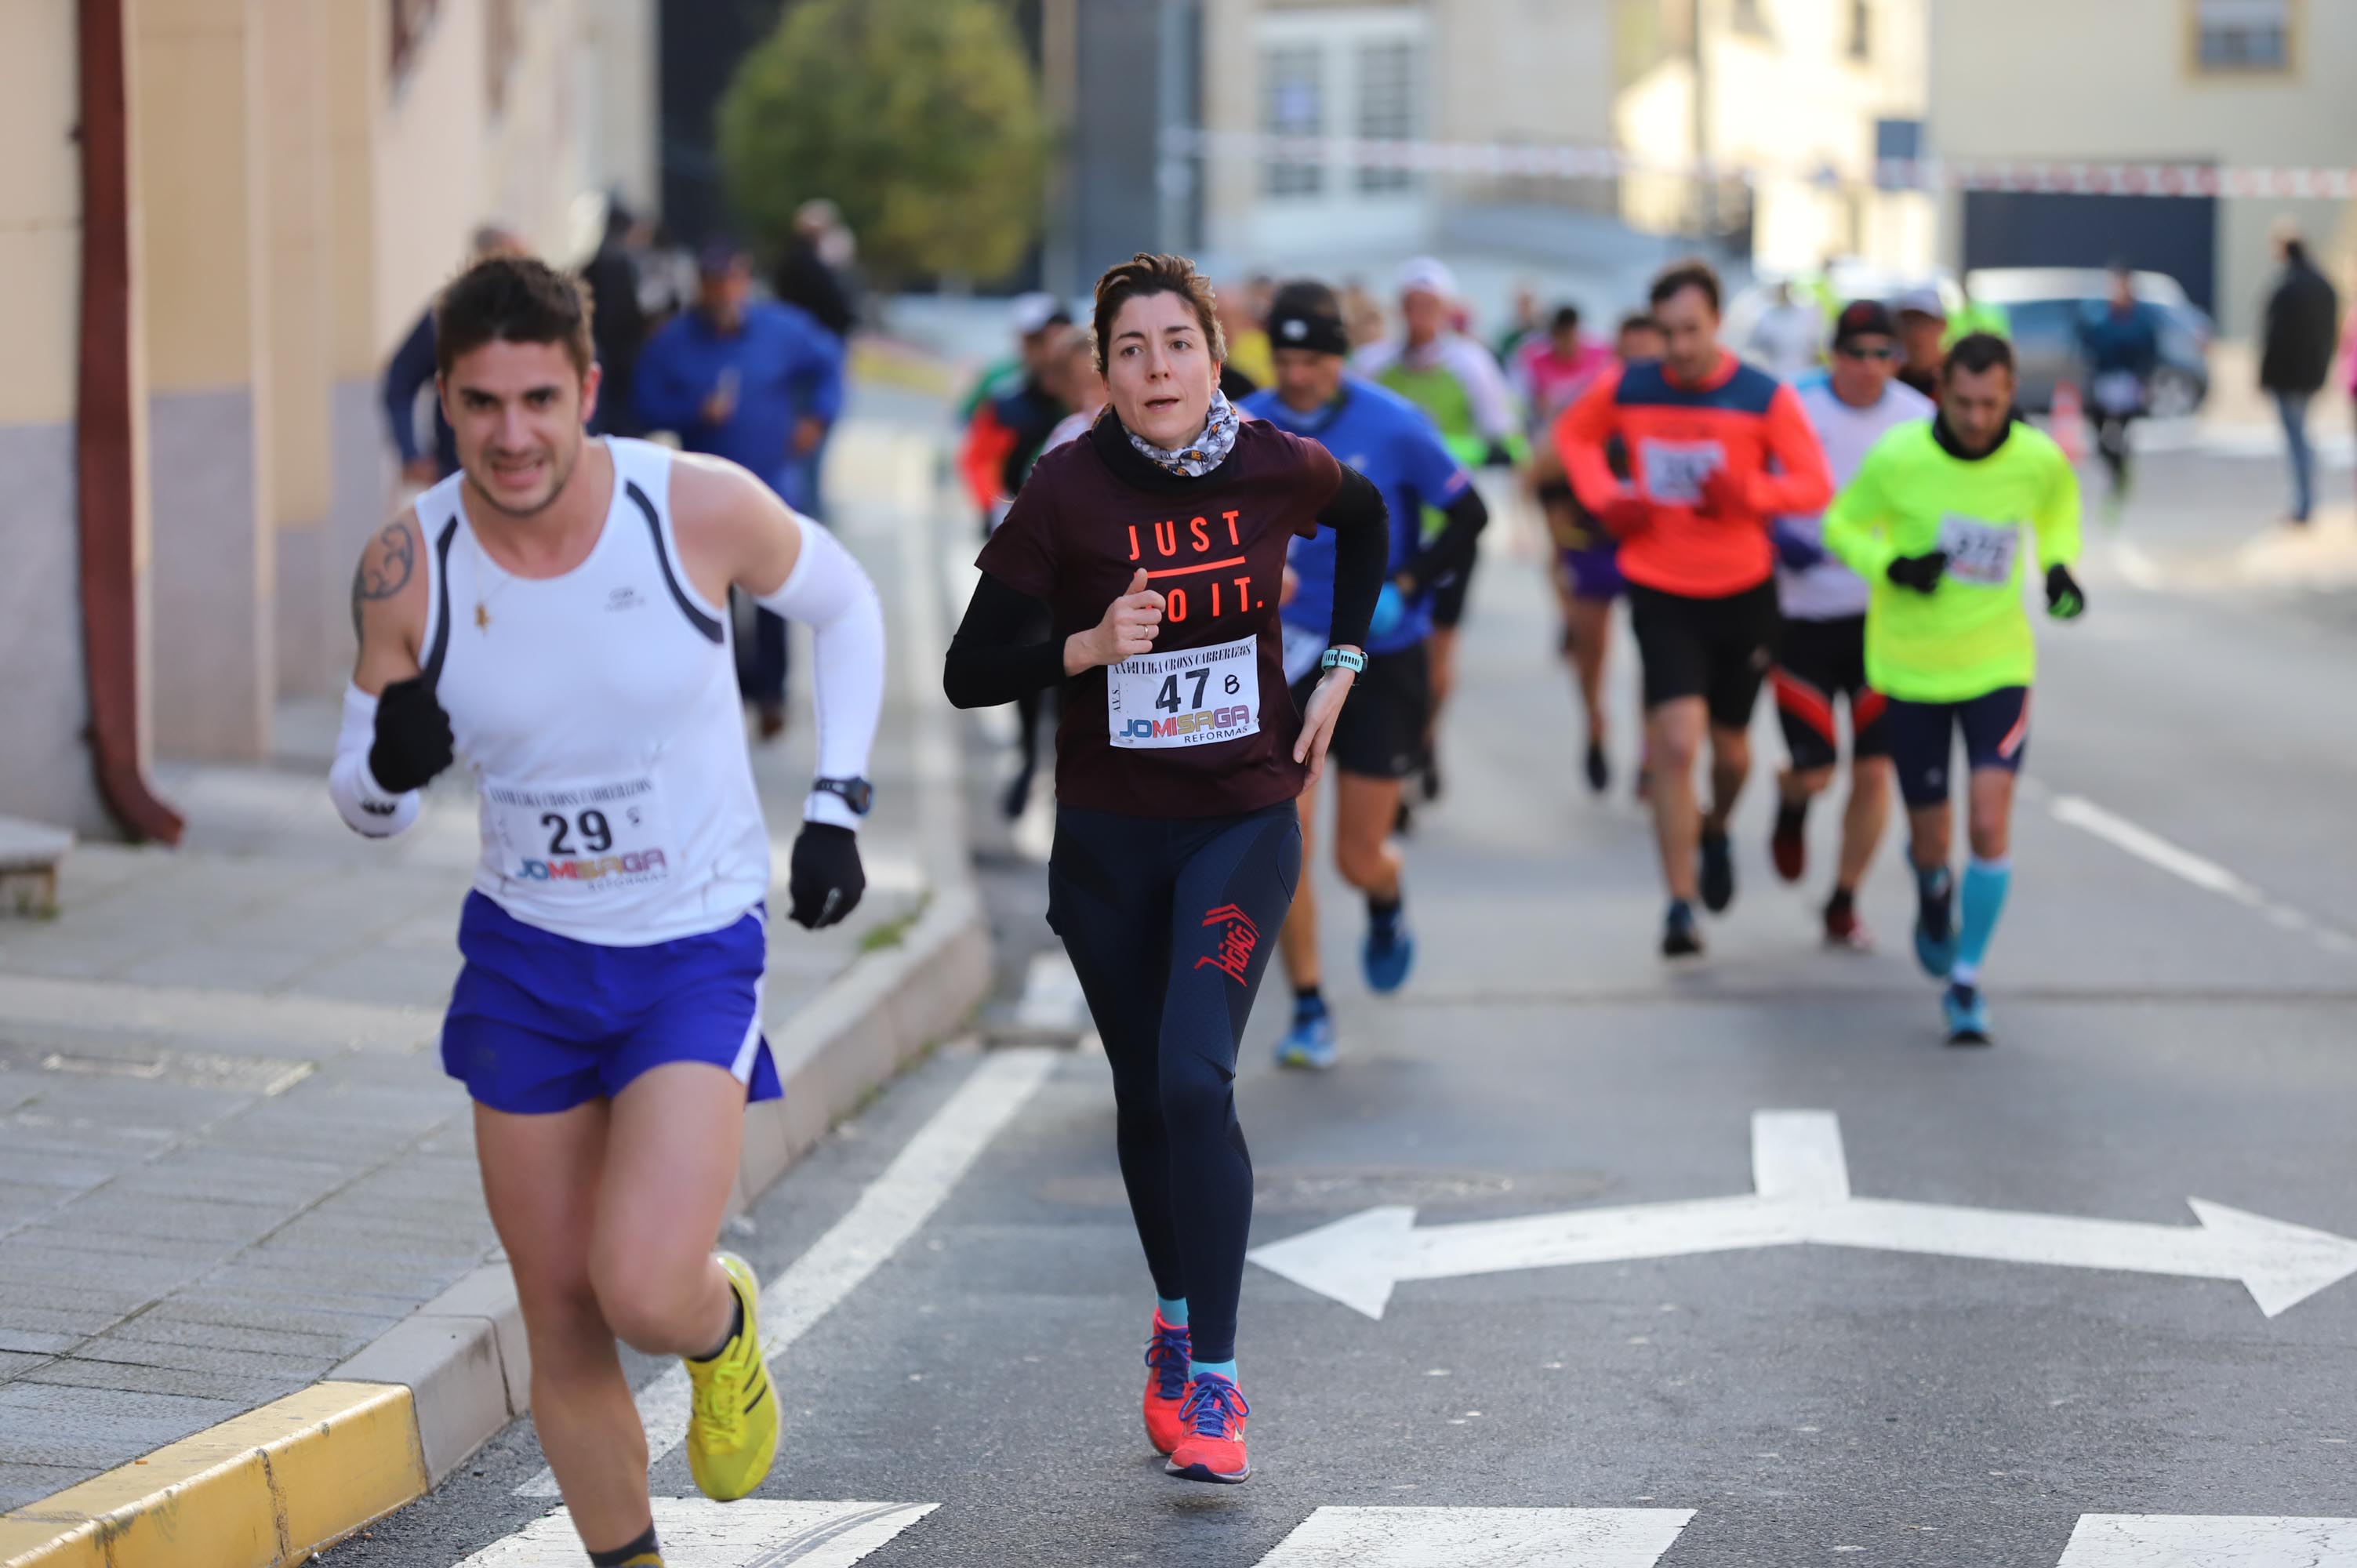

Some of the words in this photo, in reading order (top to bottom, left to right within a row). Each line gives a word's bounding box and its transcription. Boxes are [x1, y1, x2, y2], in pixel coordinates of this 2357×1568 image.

[1128, 510, 1240, 561] JUST
[1211, 576, 1263, 617] IT.
[1142, 661, 1163, 674] LIGA
[1164, 655, 1193, 672] CROSS
[1195, 644, 1251, 666] CABRERIZOS
[1155, 667, 1211, 714] 47
[1224, 673, 1240, 695] B
[1119, 705, 1250, 739] JOMISAGA
[1184, 725, 1248, 744] REFORMAS
[540, 808, 613, 855] 29
[516, 847, 667, 880] JOMISAGA
